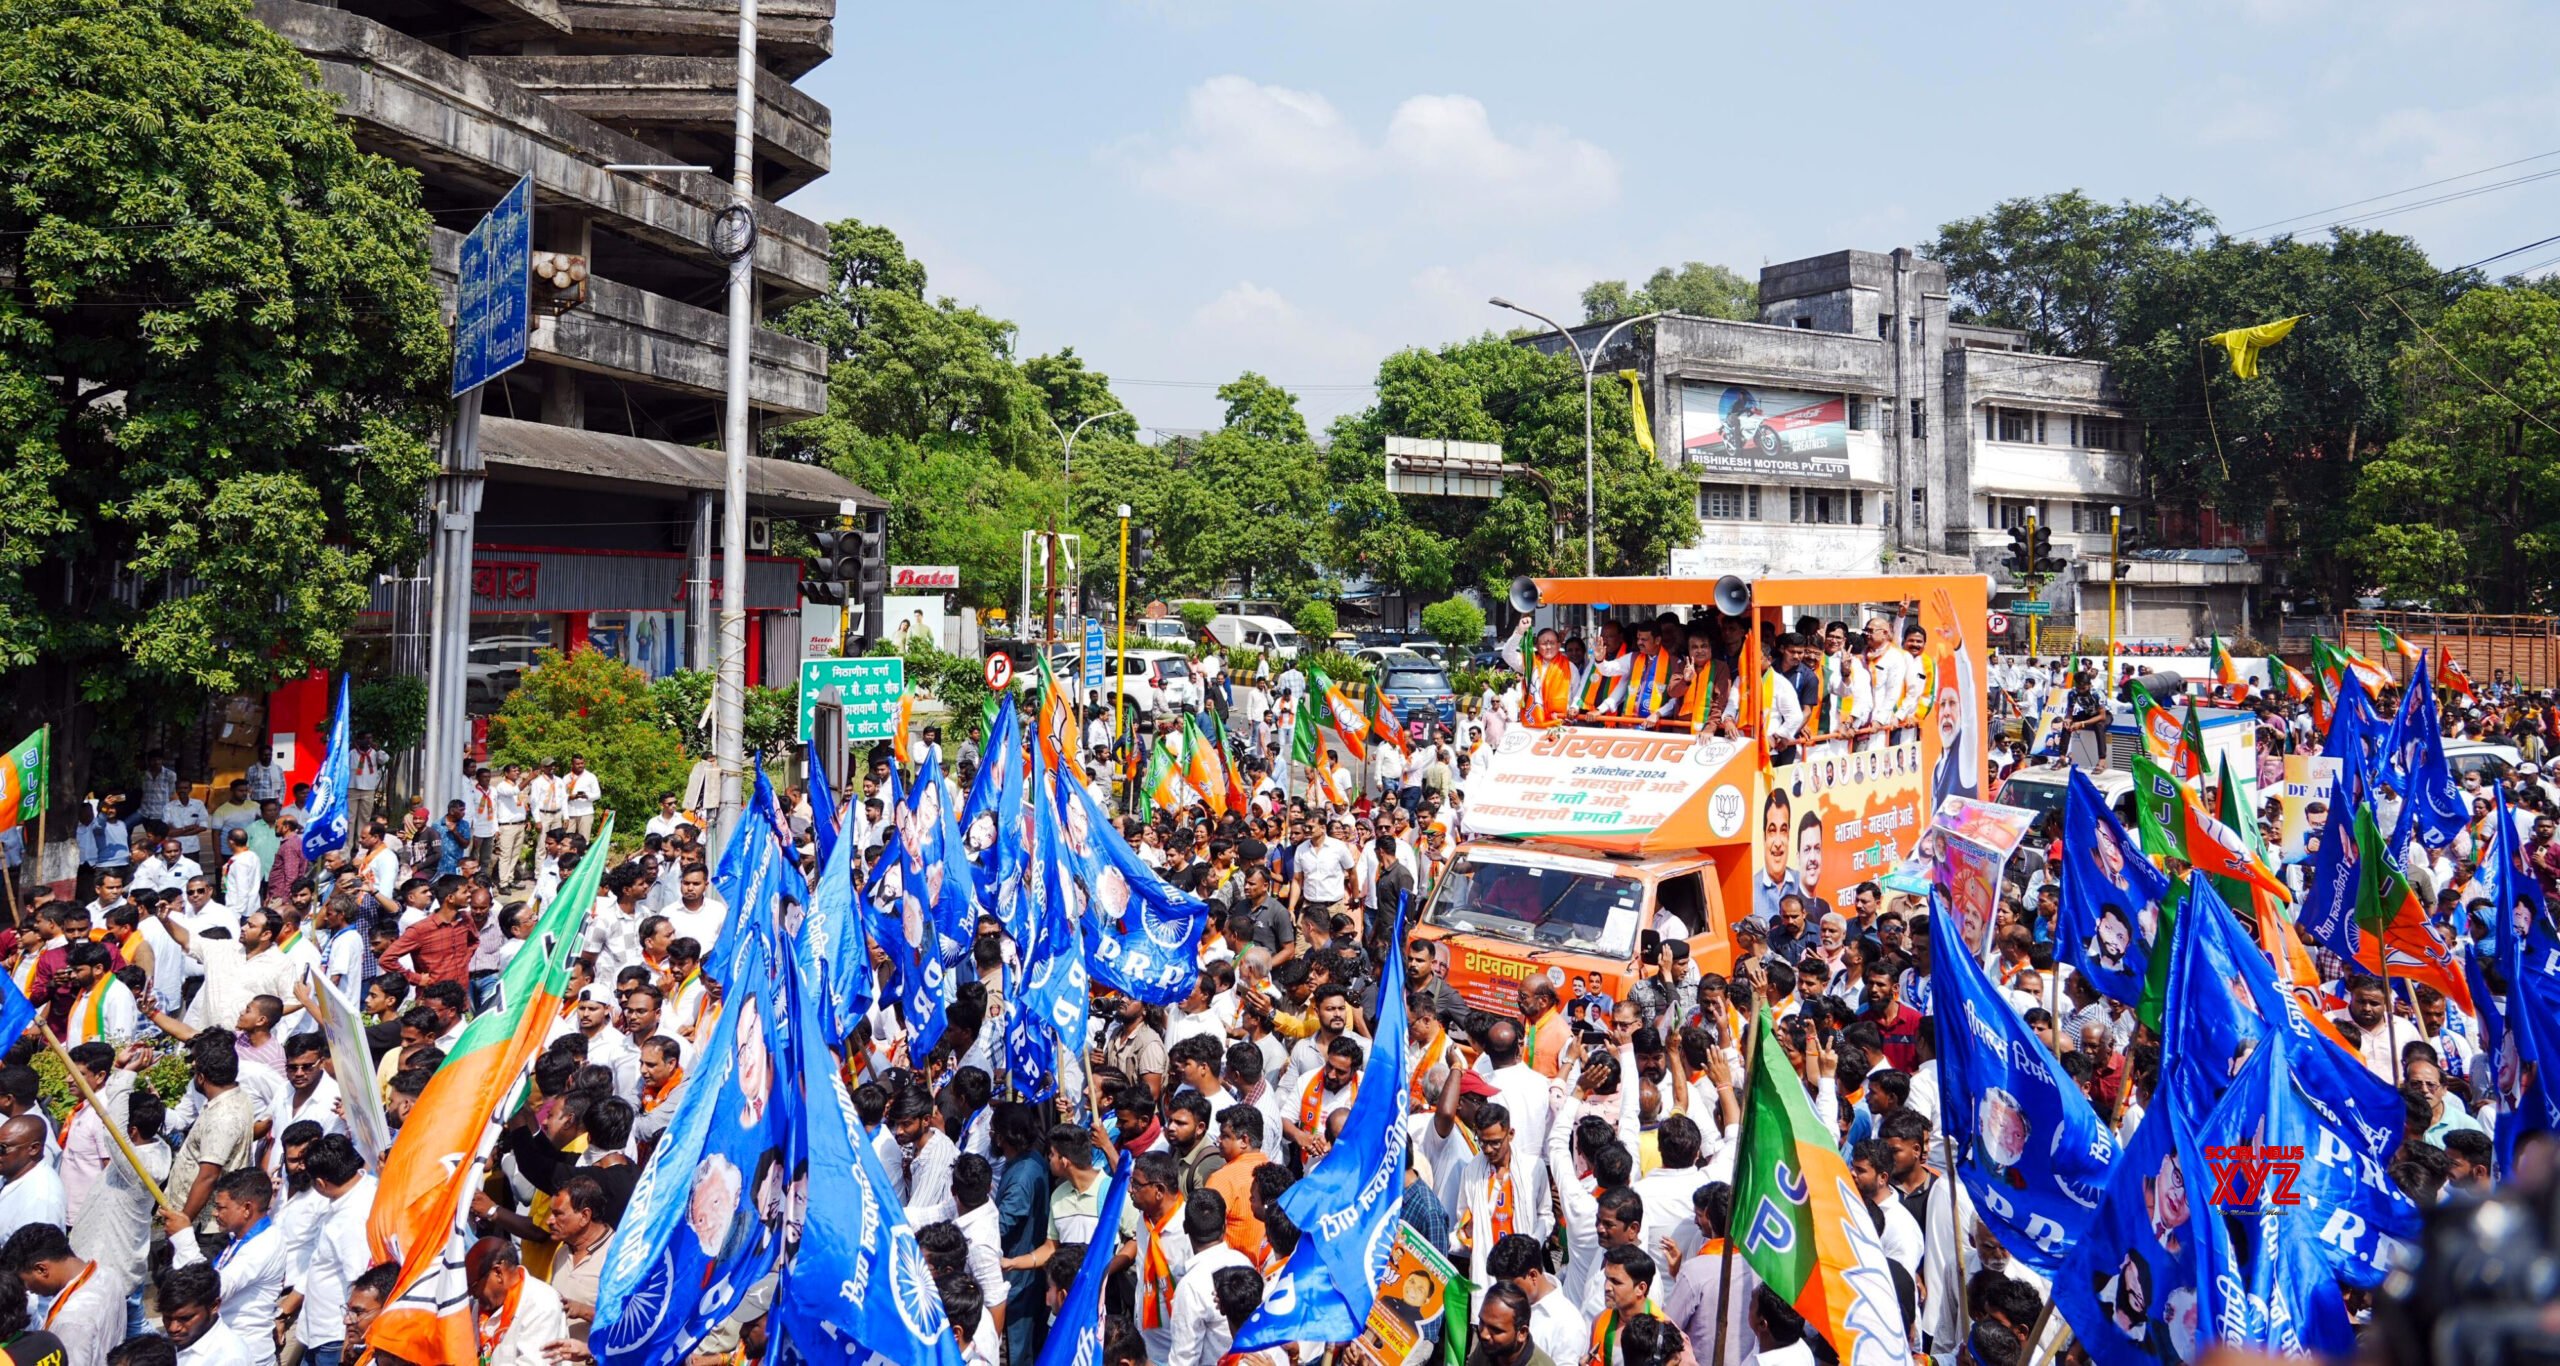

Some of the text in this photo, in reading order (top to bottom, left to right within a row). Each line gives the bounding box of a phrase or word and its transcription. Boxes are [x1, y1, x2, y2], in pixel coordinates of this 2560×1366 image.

[1793, 437, 1828, 452] GREATNESS
[1691, 454, 1752, 468] RISHIKESH
[1754, 458, 1800, 471] MOTORS
[1802, 461, 1824, 472] PVT.
[1826, 463, 1845, 474] LTD
[894, 568, 955, 587] Bata
[809, 636, 834, 644] Bata
[809, 644, 827, 652] RED
[1531, 727, 1698, 764] शंखनाद
[1572, 765, 1667, 778] 25 ऑक्टोबर 2024
[1494, 772, 1554, 787] भाजपा
[1570, 777, 1647, 793] महायुती
[1647, 780, 1690, 793] आहे
[2288, 784, 2308, 797] DF
[1521, 791, 1631, 809] तर गती आहे,
[1473, 802, 1570, 821] महाराष्ट्राची
[1571, 810, 1623, 825] प्रगती
[1834, 818, 1863, 842] भाजपा
[1868, 805, 1898, 837] महायुती
[1899, 802, 1914, 827] आहे
[1852, 850, 1865, 871] तर
[1865, 840, 1881, 867] गती
[1093, 934, 1186, 993] P.R.P.
